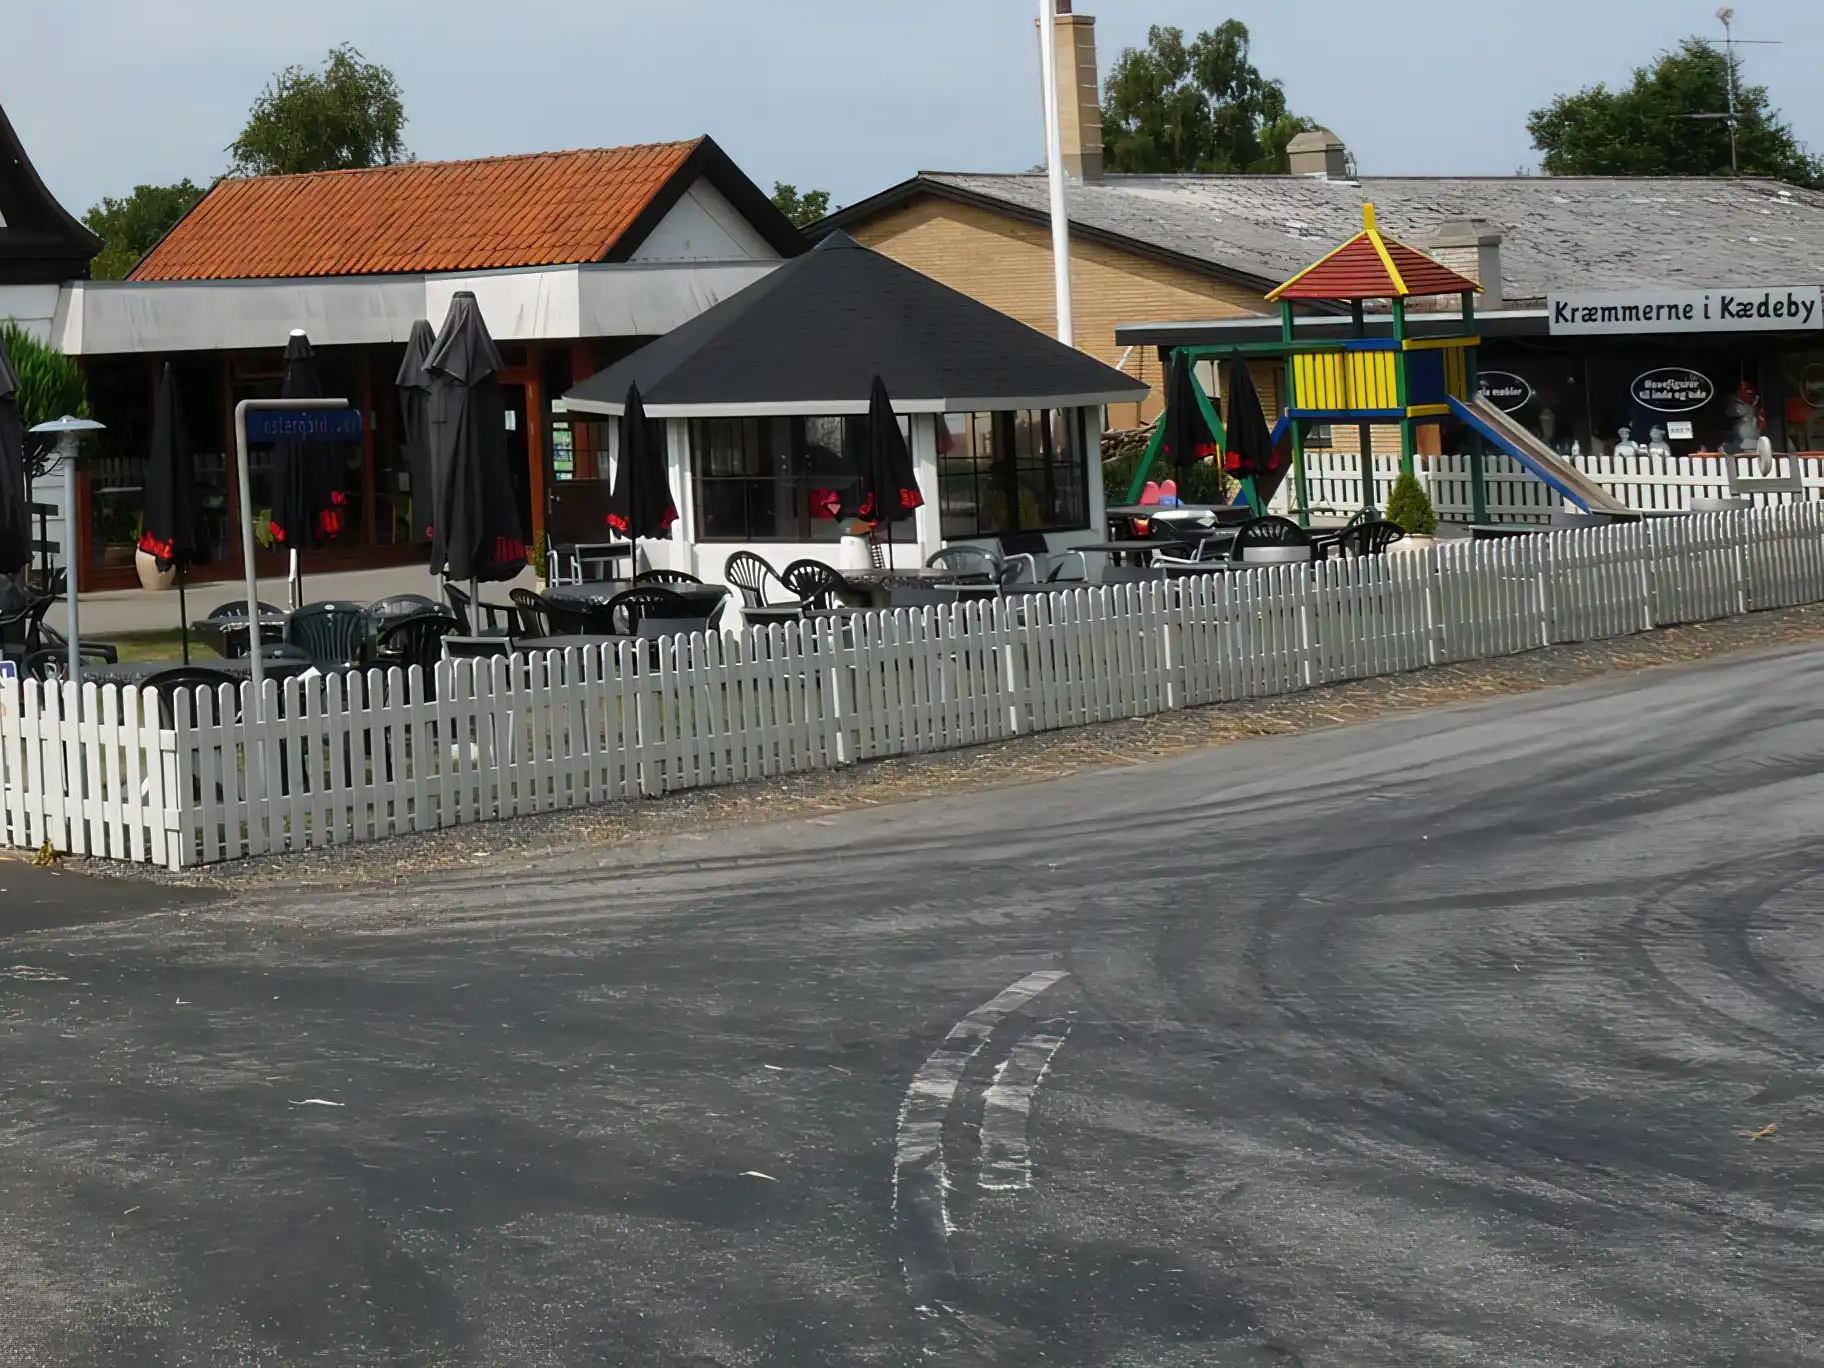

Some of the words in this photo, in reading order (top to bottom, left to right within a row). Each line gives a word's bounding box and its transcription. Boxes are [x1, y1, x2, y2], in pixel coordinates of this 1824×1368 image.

[1554, 300, 1694, 324] Kræmmerne
[1702, 294, 1711, 320] i
[1719, 292, 1816, 325] Kædeby
